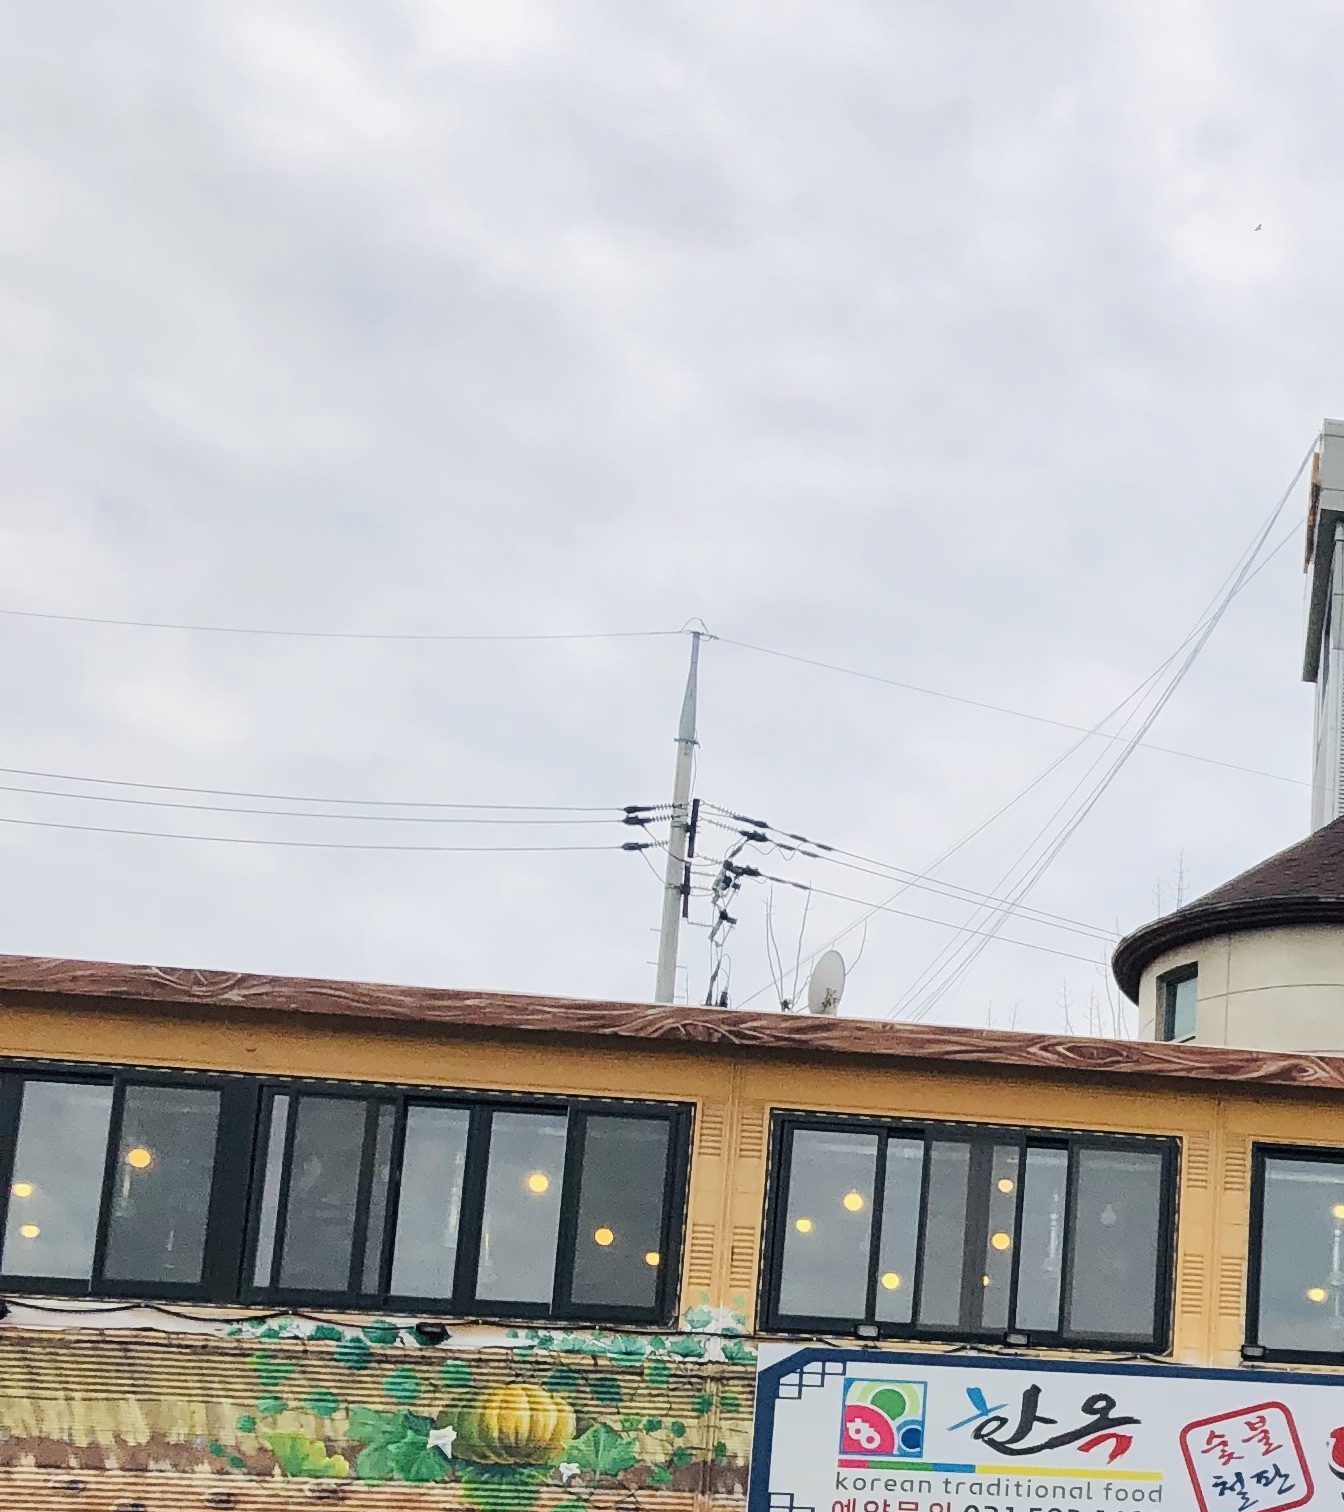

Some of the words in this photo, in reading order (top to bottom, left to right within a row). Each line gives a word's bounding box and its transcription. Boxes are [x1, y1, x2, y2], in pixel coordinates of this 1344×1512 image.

[835, 1472, 933, 1495] korean
[943, 1477, 1093, 1501] traditional
[1104, 1481, 1163, 1503] food
